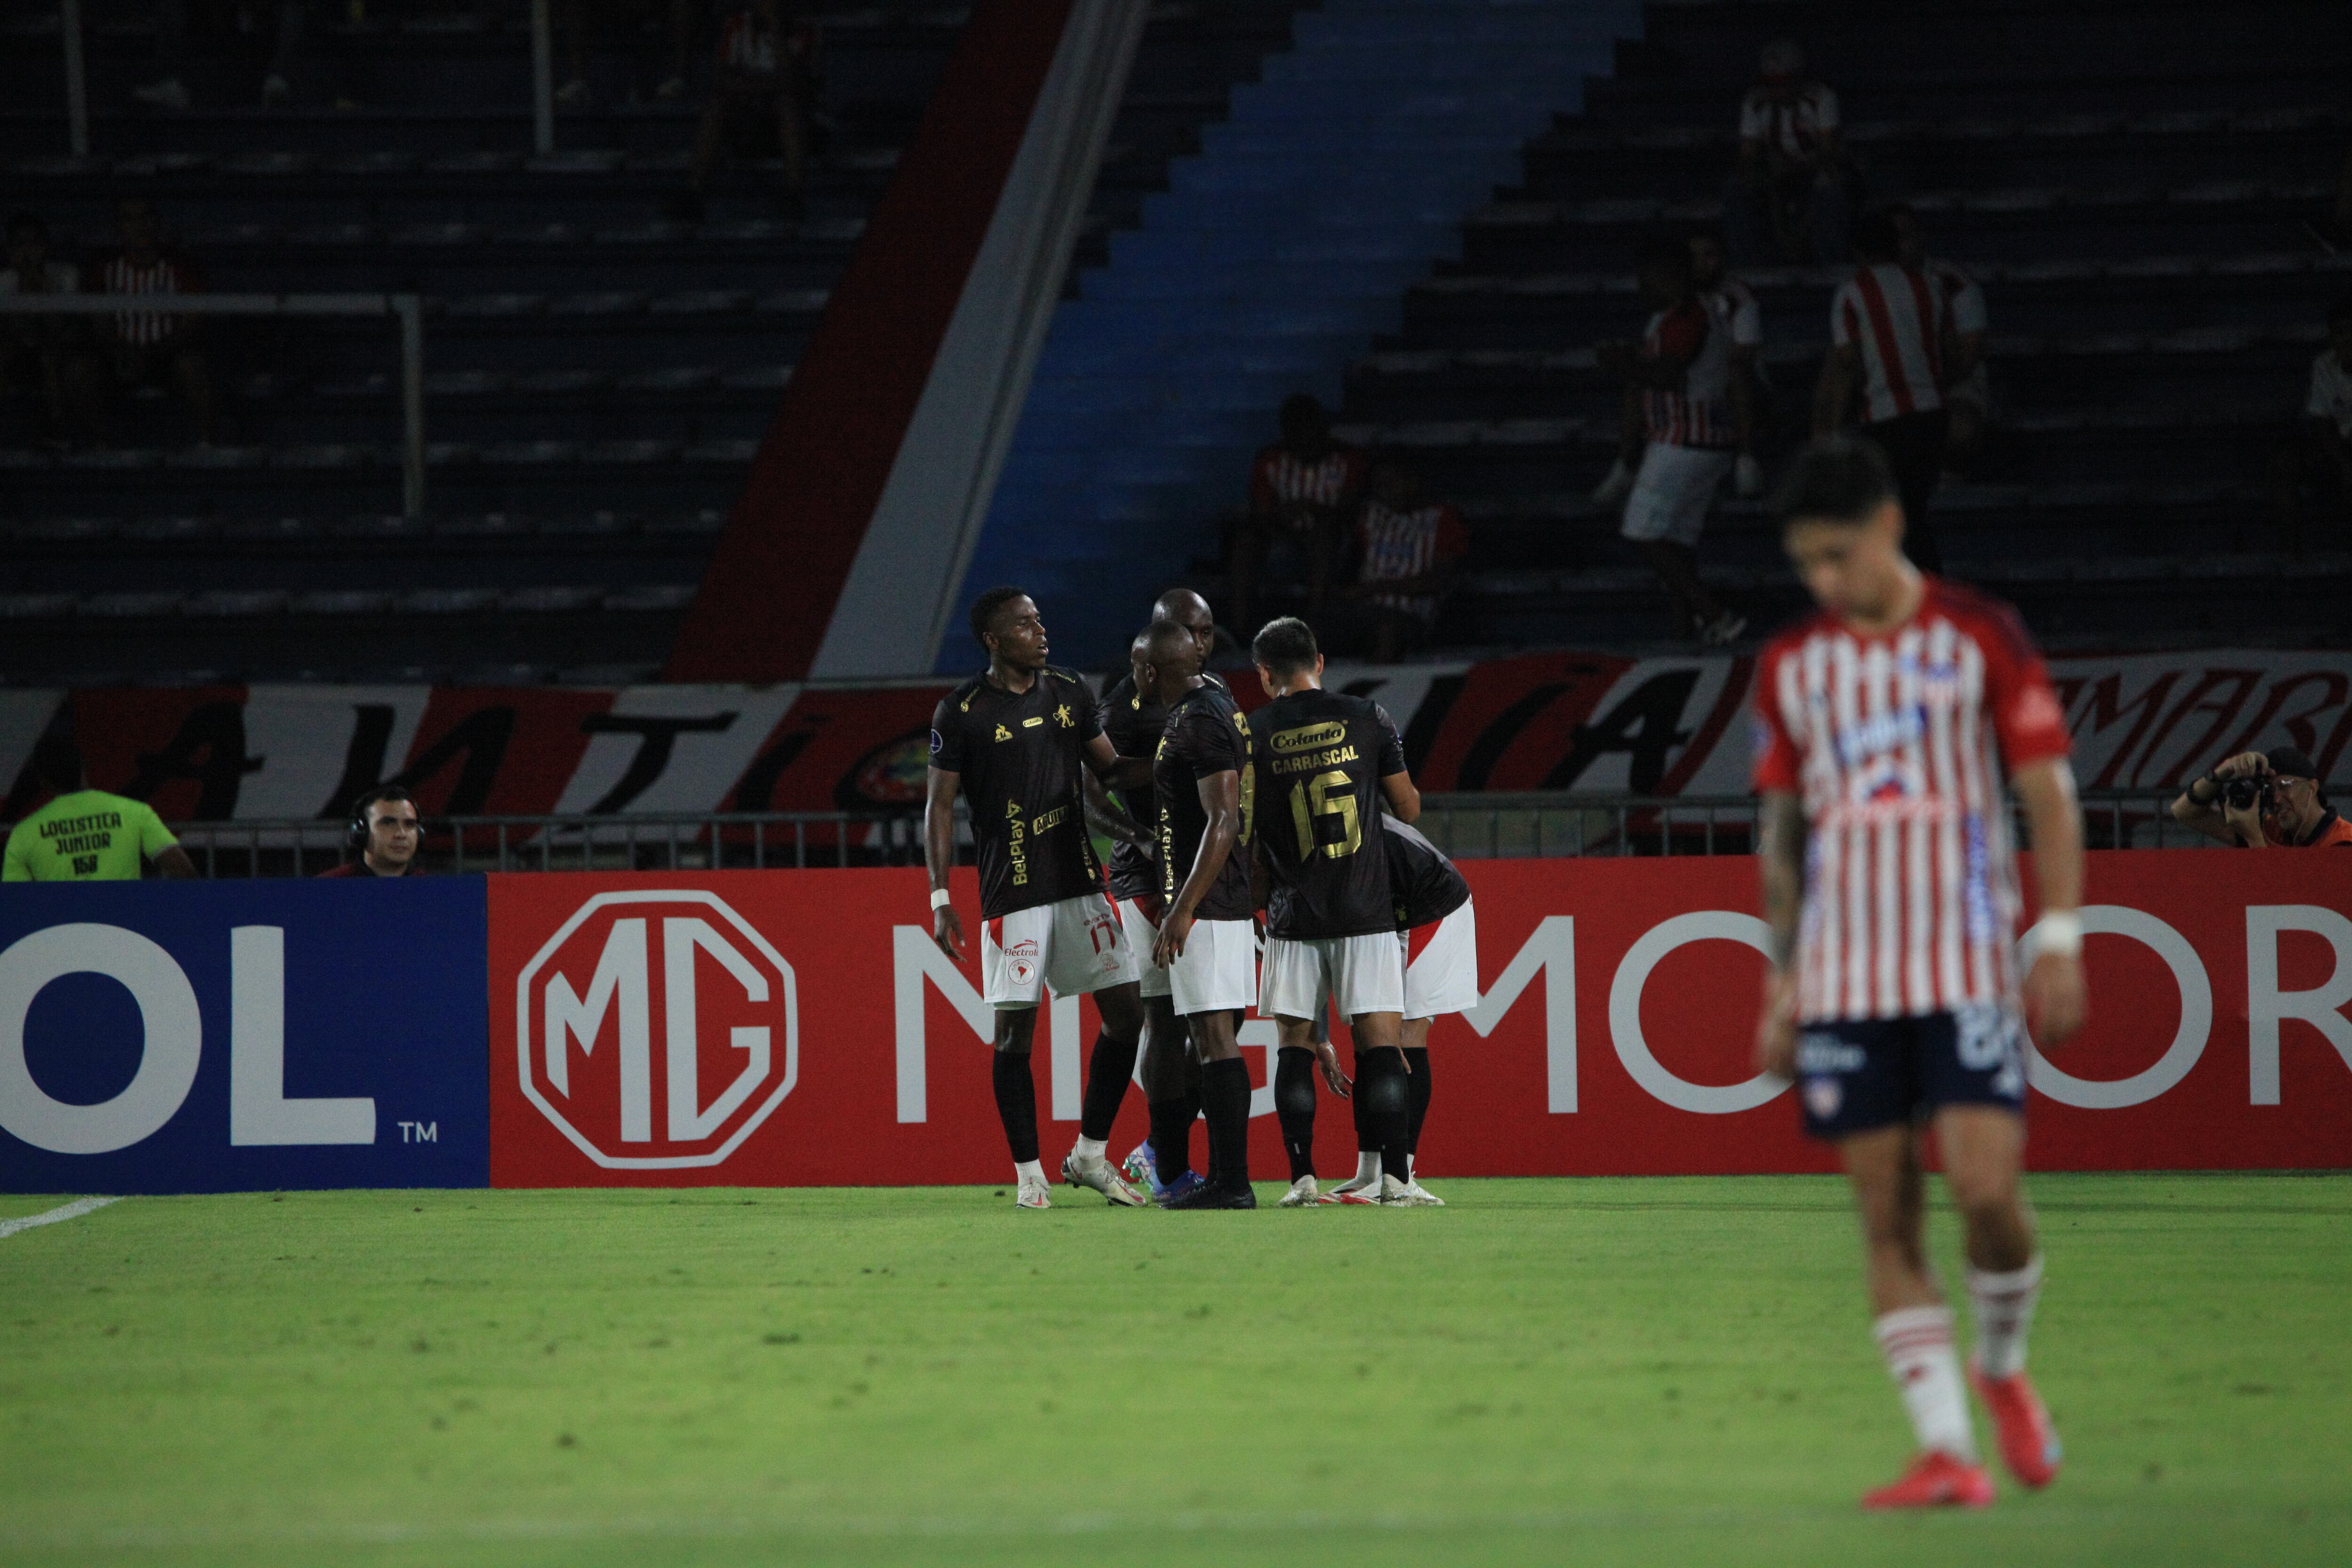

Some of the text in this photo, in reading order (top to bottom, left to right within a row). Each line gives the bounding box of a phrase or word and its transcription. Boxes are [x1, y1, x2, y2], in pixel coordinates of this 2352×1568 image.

[1272, 727, 1342, 749] Colanta
[1272, 745, 1359, 775] CARRASCAL
[40, 812, 122, 838] LOGISTICA
[1289, 770, 1362, 863] 15
[56, 832, 111, 855] JUNIOR
[1090, 920, 1117, 955] 17
[1459, 904, 2352, 1114] MOOR
[0, 922, 376, 1155] OL
[544, 915, 771, 1143] MG
[397, 1122, 438, 1144] TM
